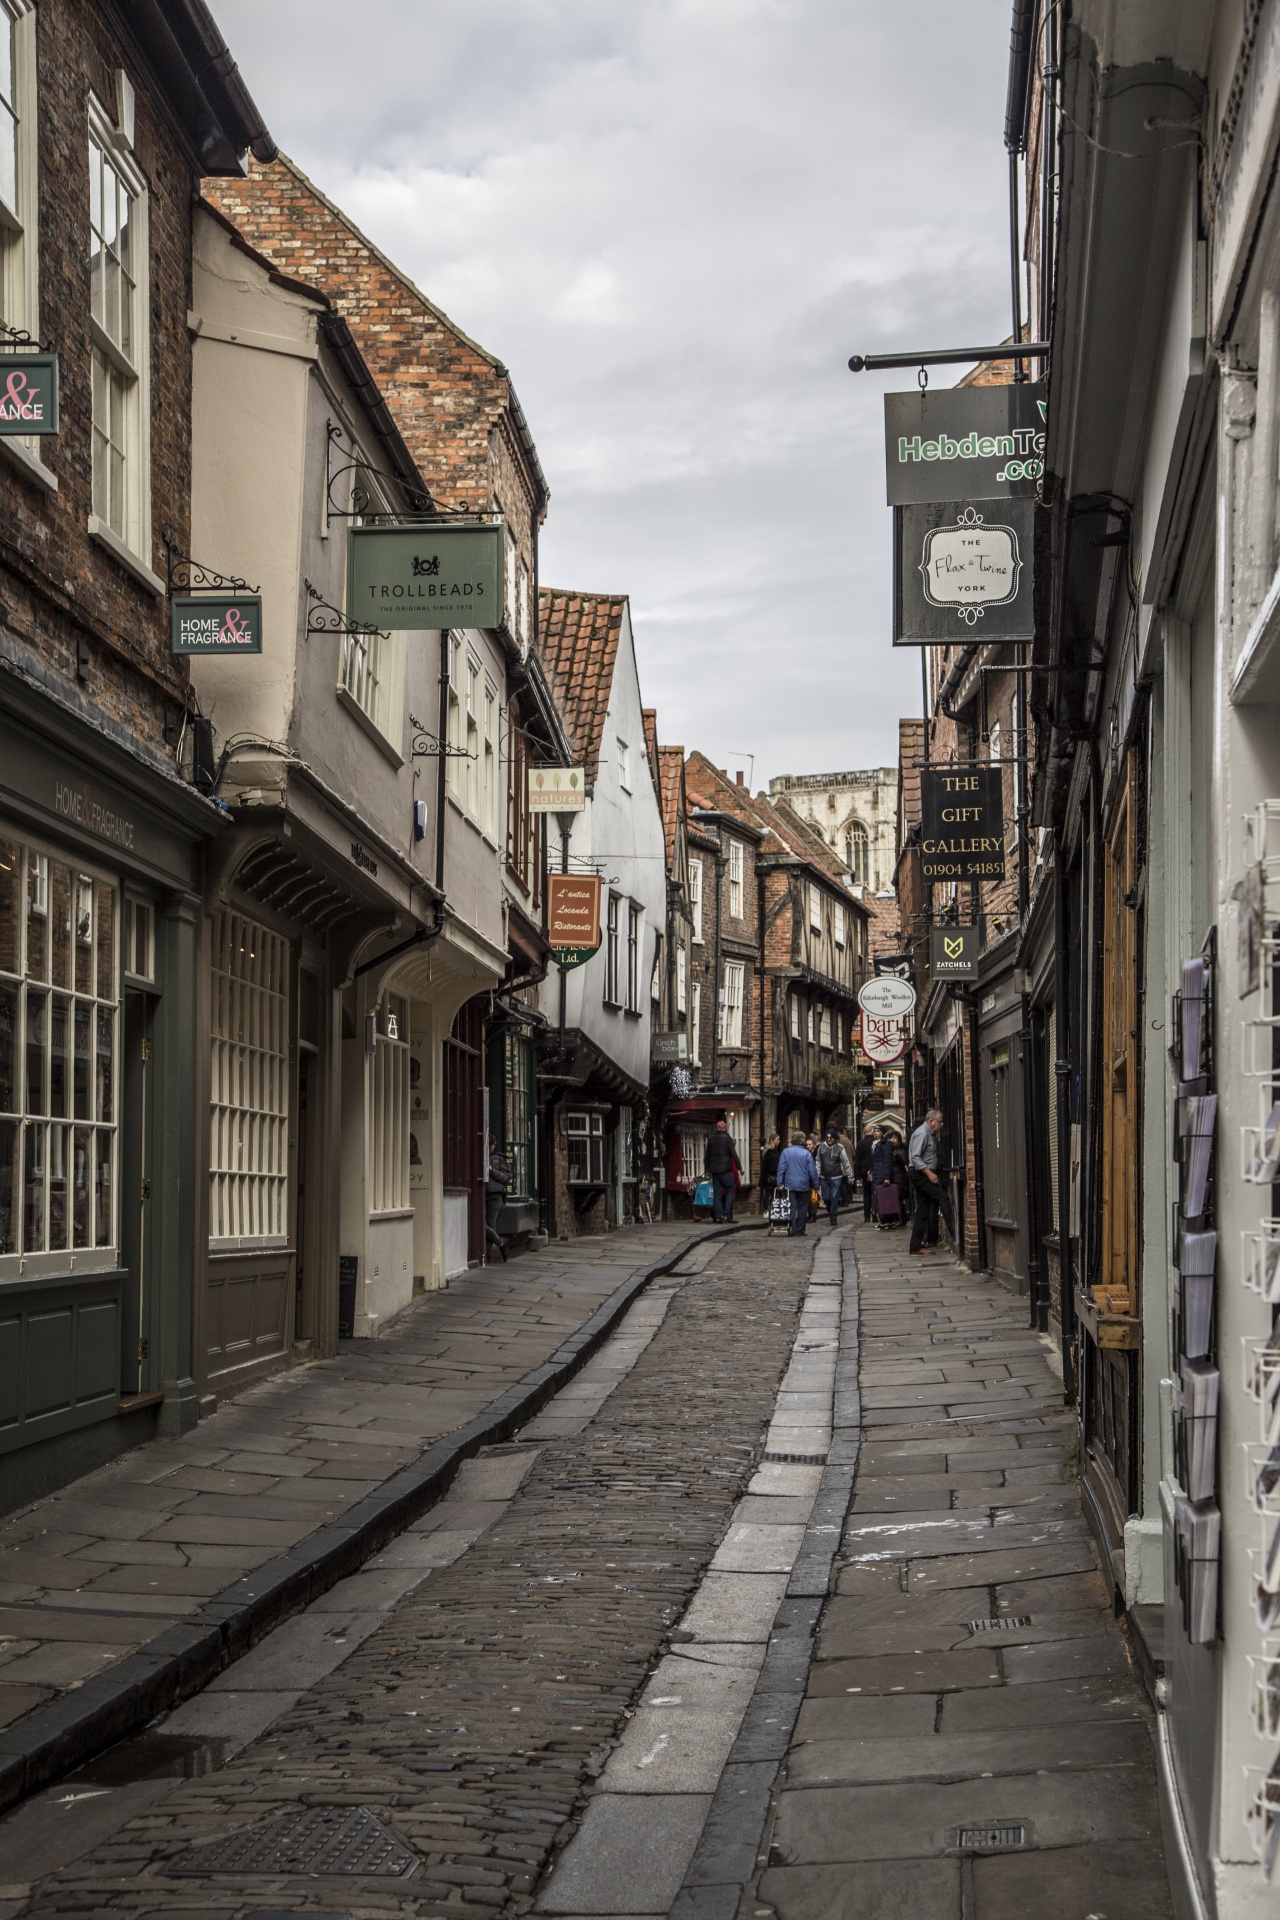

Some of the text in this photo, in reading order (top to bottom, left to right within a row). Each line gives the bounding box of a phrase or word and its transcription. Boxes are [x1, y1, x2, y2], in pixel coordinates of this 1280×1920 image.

[935, 554, 966, 579] Flax
[974, 554, 1008, 575] Twine
[368, 583, 484, 598] TROLLBEADS
[181, 619, 220, 632] HOME
[181, 631, 252, 645] FRAGRANCE
[941, 776, 980, 792] THE
[531, 793, 582, 805] natures
[55, 782, 82, 823] HOME
[91, 802, 134, 850] FRAGRANCE
[941, 807, 983, 823] GIFT
[922, 837, 1003, 854] GALLERY
[923, 862, 1005, 876] 01904 541851
[556, 904, 589, 915] Locanda
[553, 921, 592, 931] Ristorante
[561, 952, 579, 963] Ltd.
[655, 1039, 676, 1047] lunch
